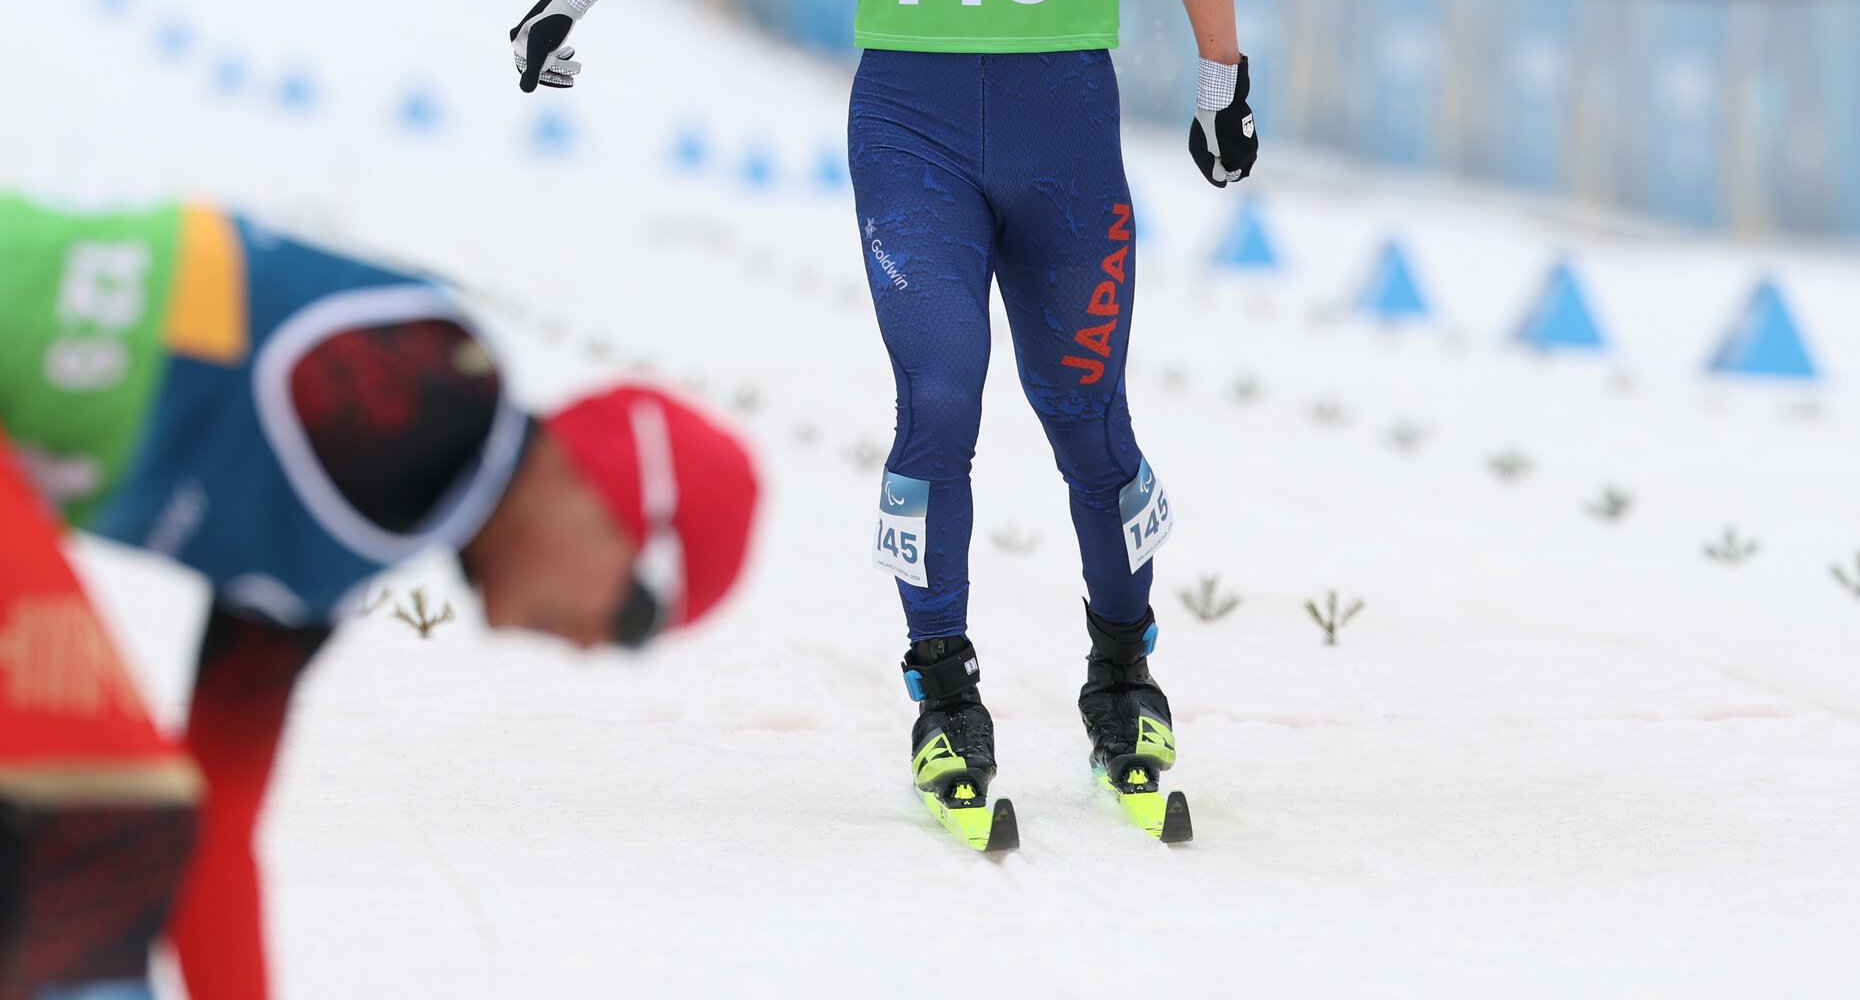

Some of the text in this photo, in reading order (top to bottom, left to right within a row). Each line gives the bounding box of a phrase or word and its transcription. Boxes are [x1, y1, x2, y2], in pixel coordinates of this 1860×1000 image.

[871, 239, 908, 291] Goldwin
[1060, 203, 1131, 385] JAPAN
[877, 517, 918, 564] 145
[1129, 489, 1169, 550] 145
